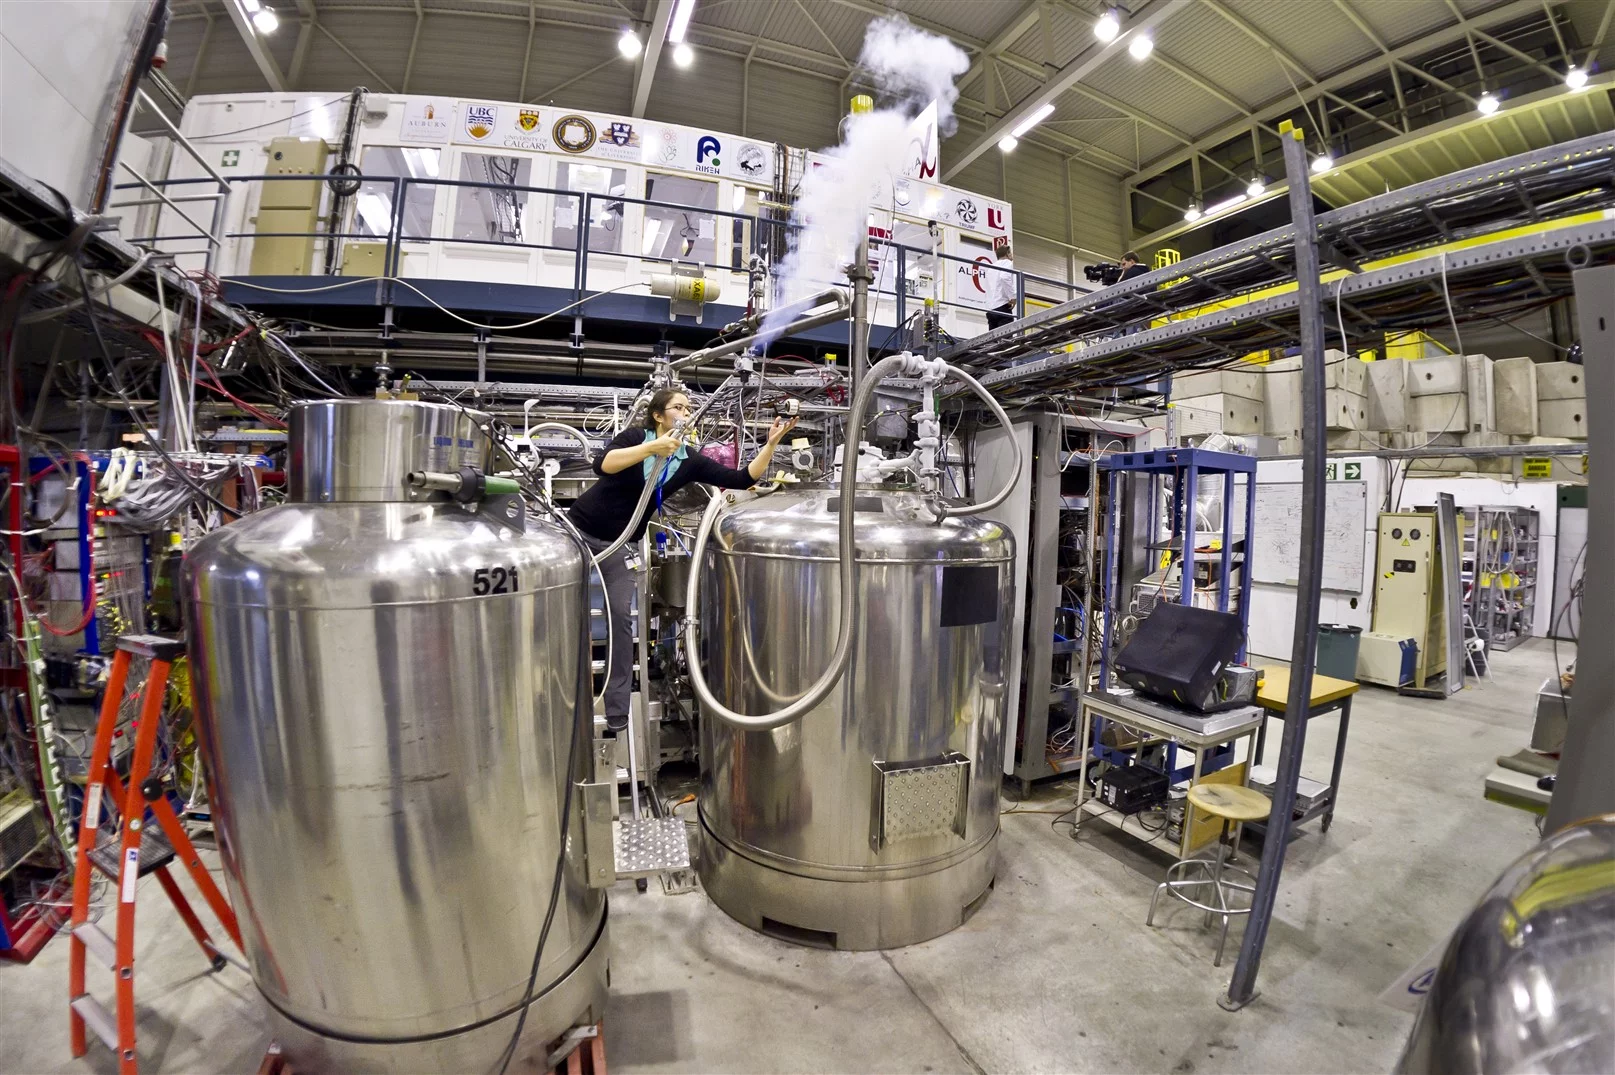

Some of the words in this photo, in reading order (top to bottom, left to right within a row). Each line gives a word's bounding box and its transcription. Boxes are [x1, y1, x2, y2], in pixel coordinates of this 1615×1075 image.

[469, 106, 495, 117] UBC
[407, 120, 447, 128] AUBURN
[503, 139, 548, 150] CALGARY
[696, 164, 720, 175] RIKEN
[958, 265, 986, 279] ALPH
[472, 564, 519, 597] 521
